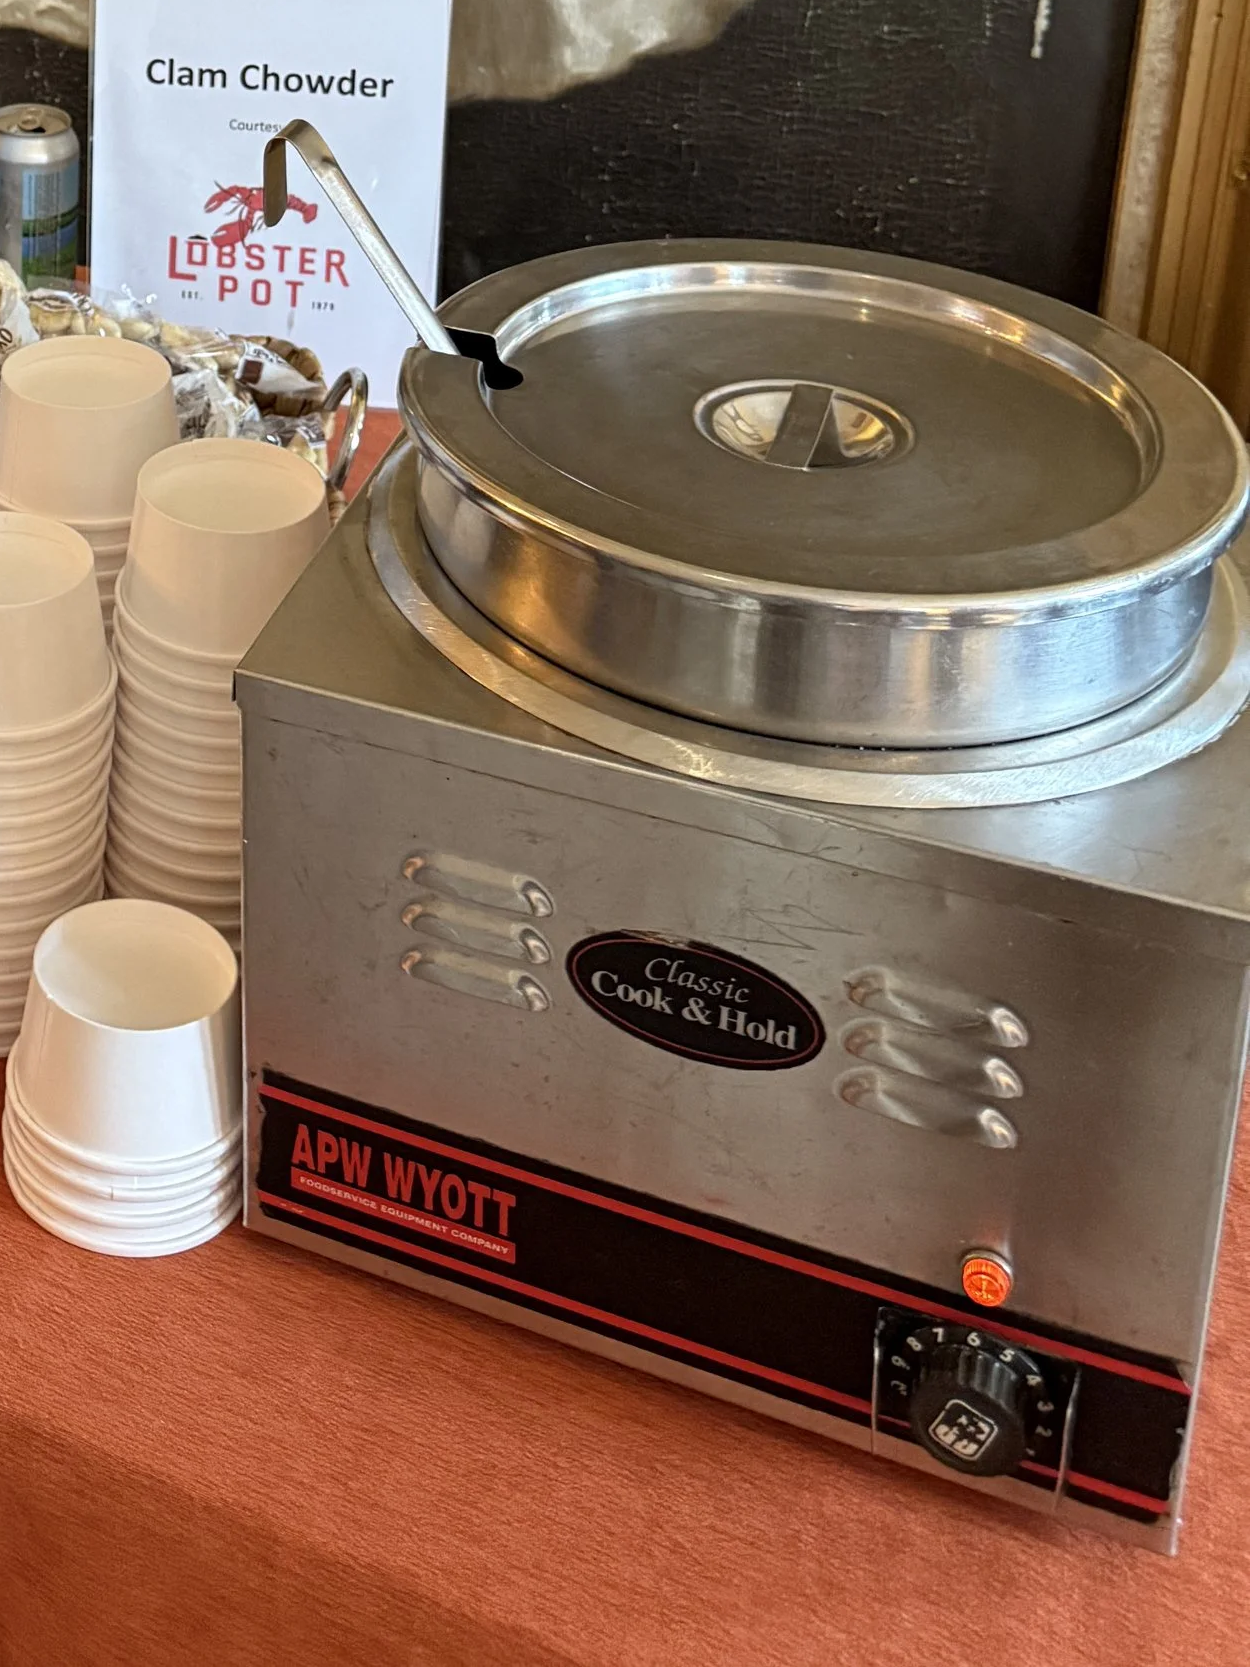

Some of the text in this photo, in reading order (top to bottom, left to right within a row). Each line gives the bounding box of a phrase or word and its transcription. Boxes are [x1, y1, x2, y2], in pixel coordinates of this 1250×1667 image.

[146, 58, 395, 98] Clam Chowder
[168, 234, 350, 287] LOBSTER
[218, 275, 305, 308] POT
[645, 957, 750, 1004] Classic
[591, 970, 797, 1051] Cook & Hold
[291, 1123, 516, 1236] APW WYOTT
[300, 1176, 509, 1255] FOODSERVICE EQUIPMENT COMPANY
[906, 1336, 923, 1352] 8
[932, 1327, 945, 1343] 7
[966, 1332, 981, 1346] 6
[1000, 1349, 1015, 1362] 5
[1026, 1374, 1043, 1387] 4
